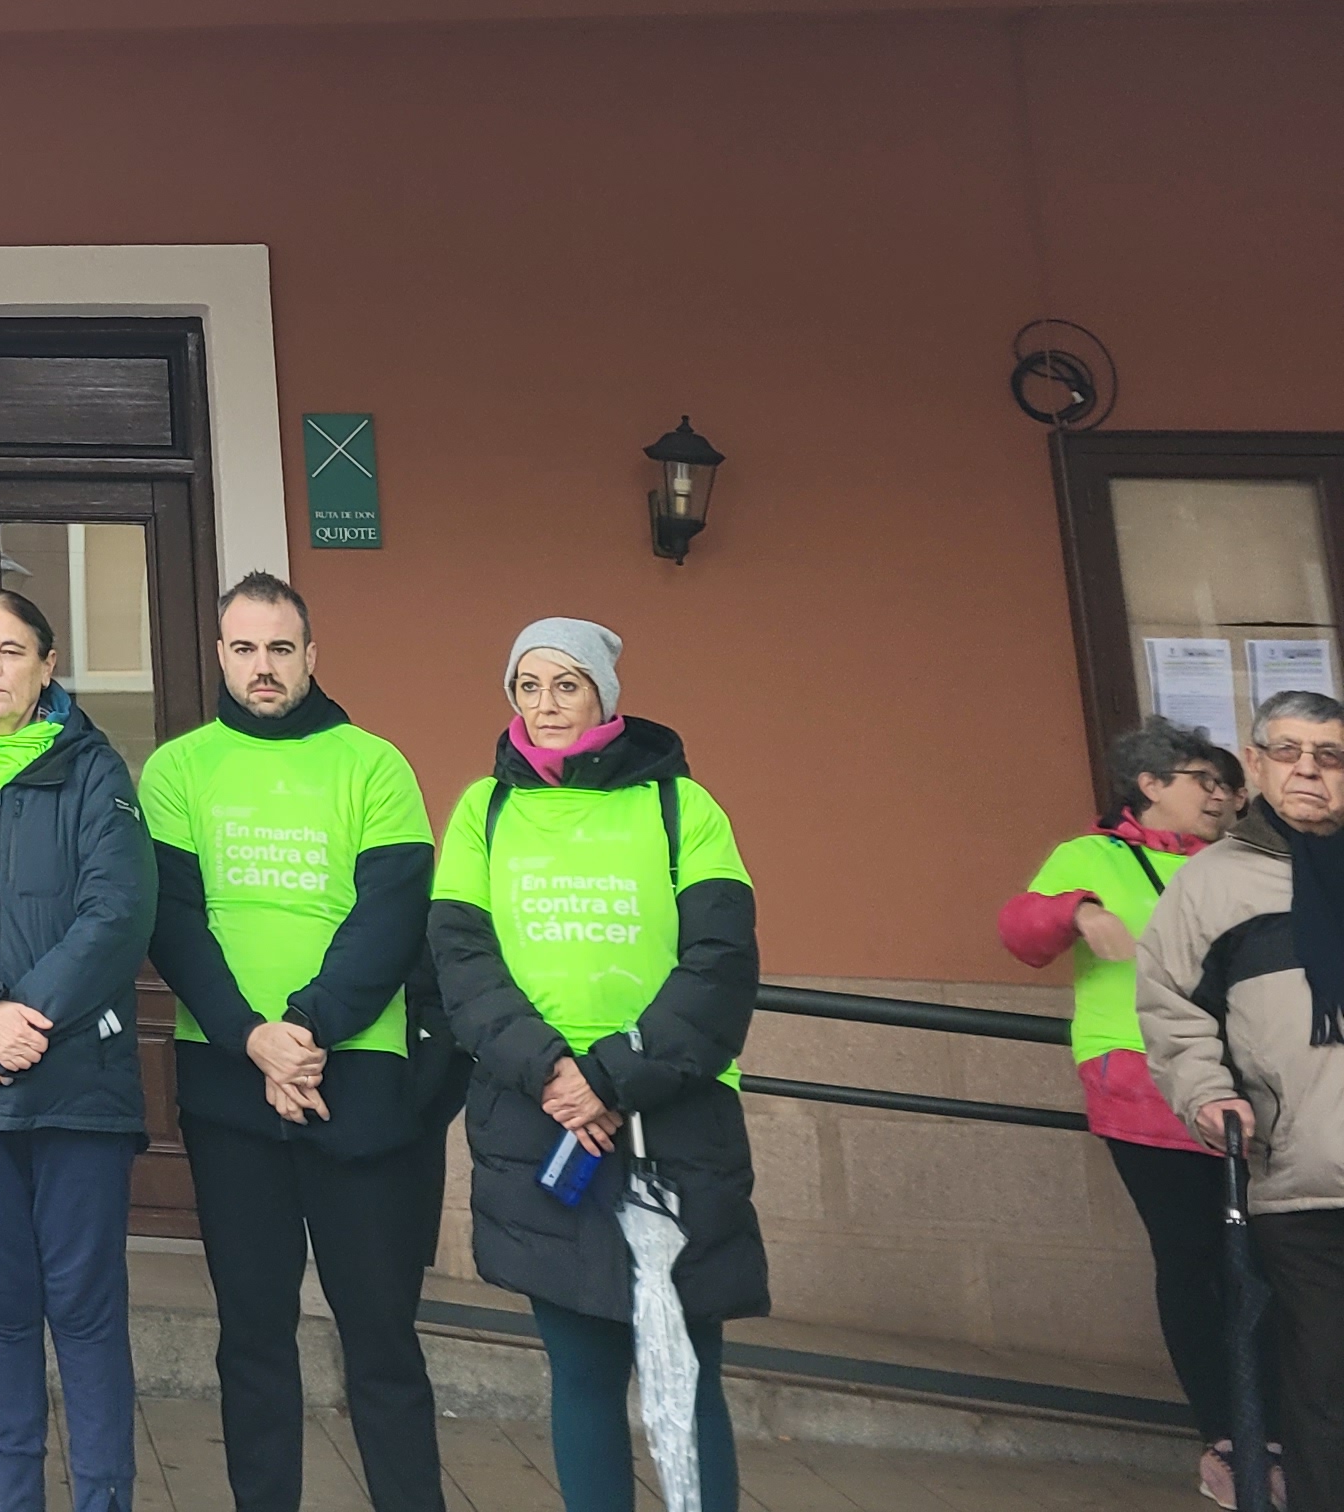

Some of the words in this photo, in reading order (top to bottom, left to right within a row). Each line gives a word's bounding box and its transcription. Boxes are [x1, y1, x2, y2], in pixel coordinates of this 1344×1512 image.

[315, 511, 338, 519] RUTA
[341, 511, 352, 519] DE
[355, 511, 375, 519] DON
[315, 527, 377, 543] QUIJOTE
[225, 821, 250, 837] En
[254, 825, 329, 844] marcha
[225, 843, 302, 863] contra
[305, 847, 329, 867] el
[226, 862, 330, 891] cáncer
[521, 873, 547, 891] En
[551, 873, 638, 892] marcha
[521, 893, 608, 914] contra
[613, 895, 641, 917] el
[526, 914, 642, 945] cáncer
